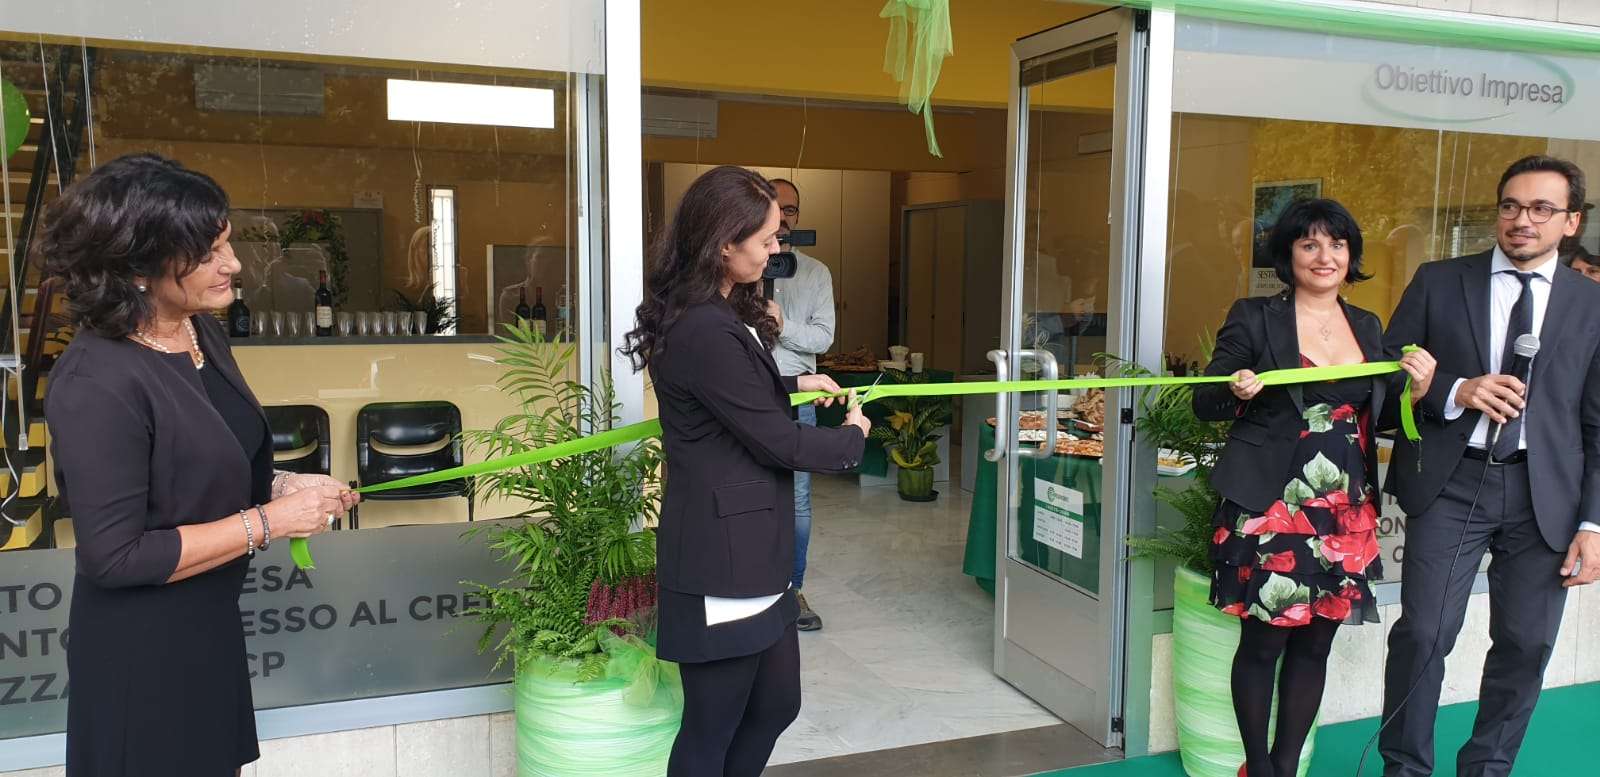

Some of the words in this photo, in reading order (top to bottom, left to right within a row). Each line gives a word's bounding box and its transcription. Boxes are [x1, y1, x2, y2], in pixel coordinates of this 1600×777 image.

[1376, 63, 1473, 96] Obiettivo
[1480, 73, 1564, 105] Impresa
[0, 582, 62, 614] TO
[241, 565, 313, 594] ESA
[0, 627, 69, 660] NT
[241, 604, 337, 637] ESSO
[350, 600, 397, 627] AL
[409, 591, 491, 621] CRE
[0, 673, 69, 706] ZZ
